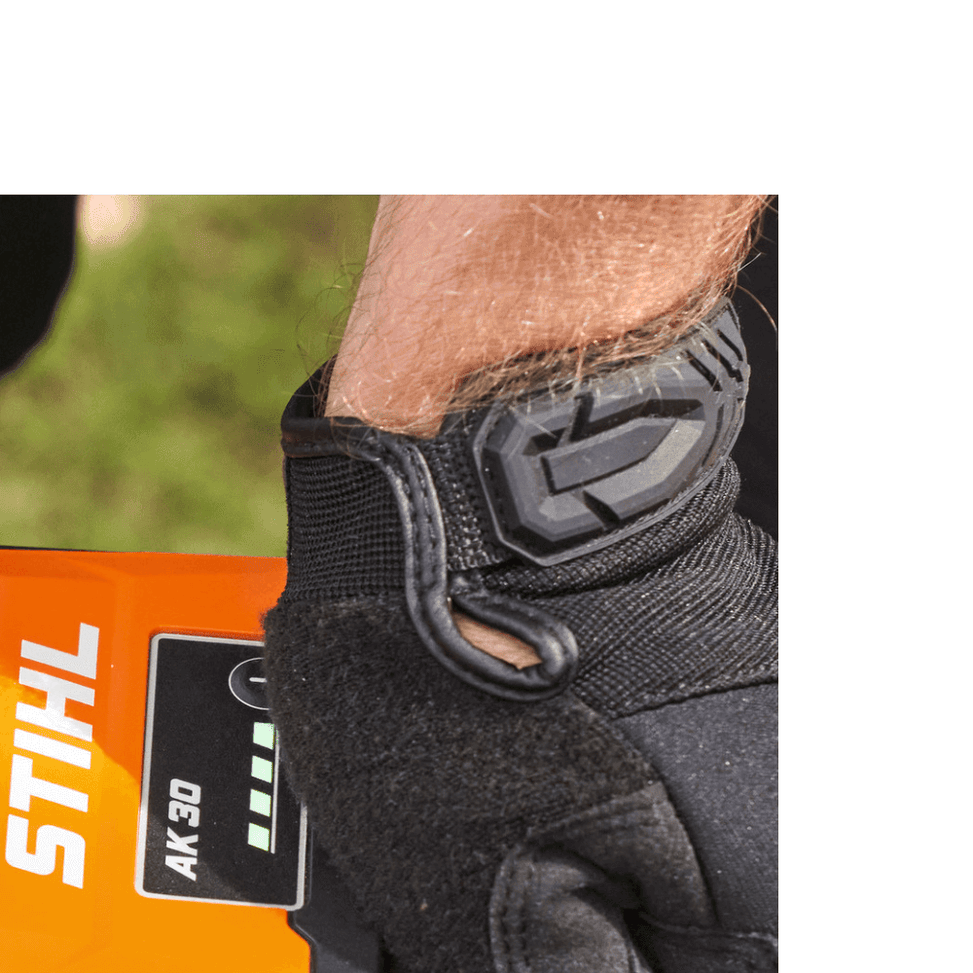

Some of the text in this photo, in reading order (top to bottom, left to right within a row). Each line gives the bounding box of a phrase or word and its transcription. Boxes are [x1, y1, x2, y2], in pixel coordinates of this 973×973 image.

[5, 622, 100, 889] STIHL
[165, 778, 201, 882] AK 30
